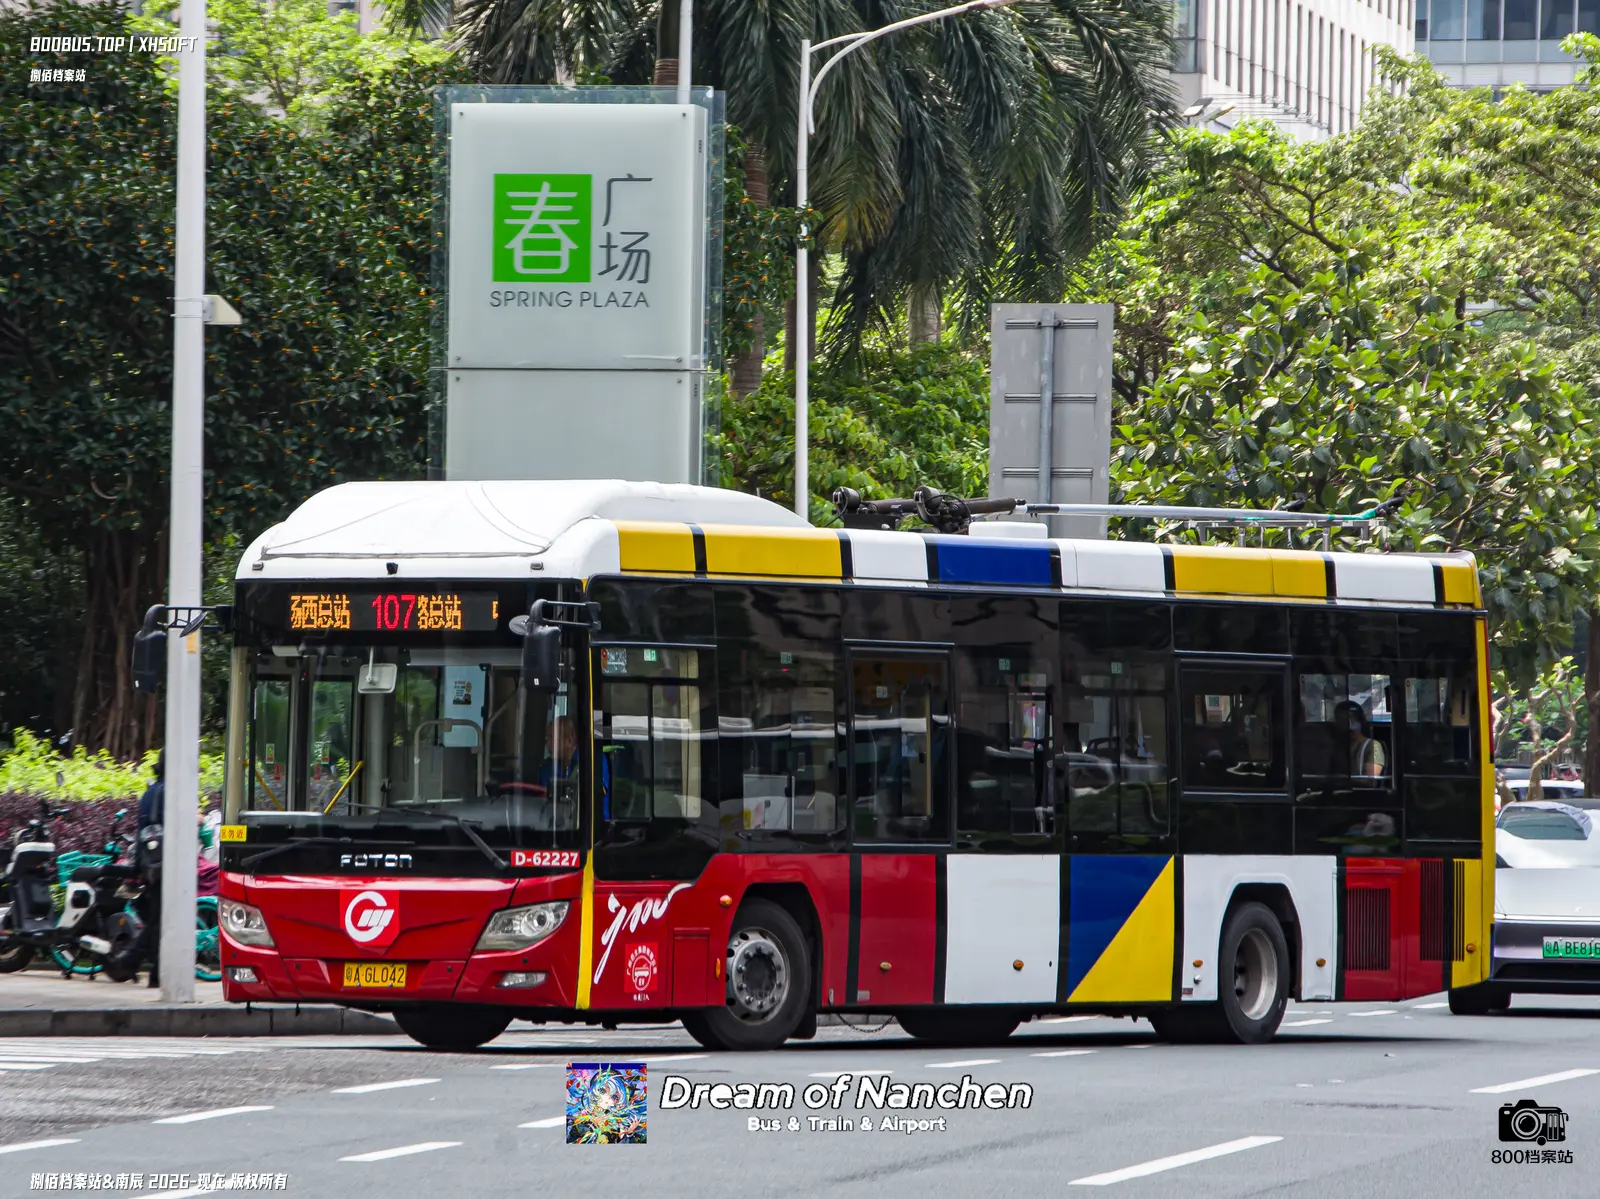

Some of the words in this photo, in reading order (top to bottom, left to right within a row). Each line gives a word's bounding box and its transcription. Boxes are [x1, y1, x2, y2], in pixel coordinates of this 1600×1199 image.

[503, 181, 580, 274] 春
[489, 290, 573, 308] SPRING
[579, 291, 650, 308] PLAZA
[371, 594, 416, 629] 107
[340, 853, 413, 868] FOTON
[515, 851, 579, 866] D-62227
